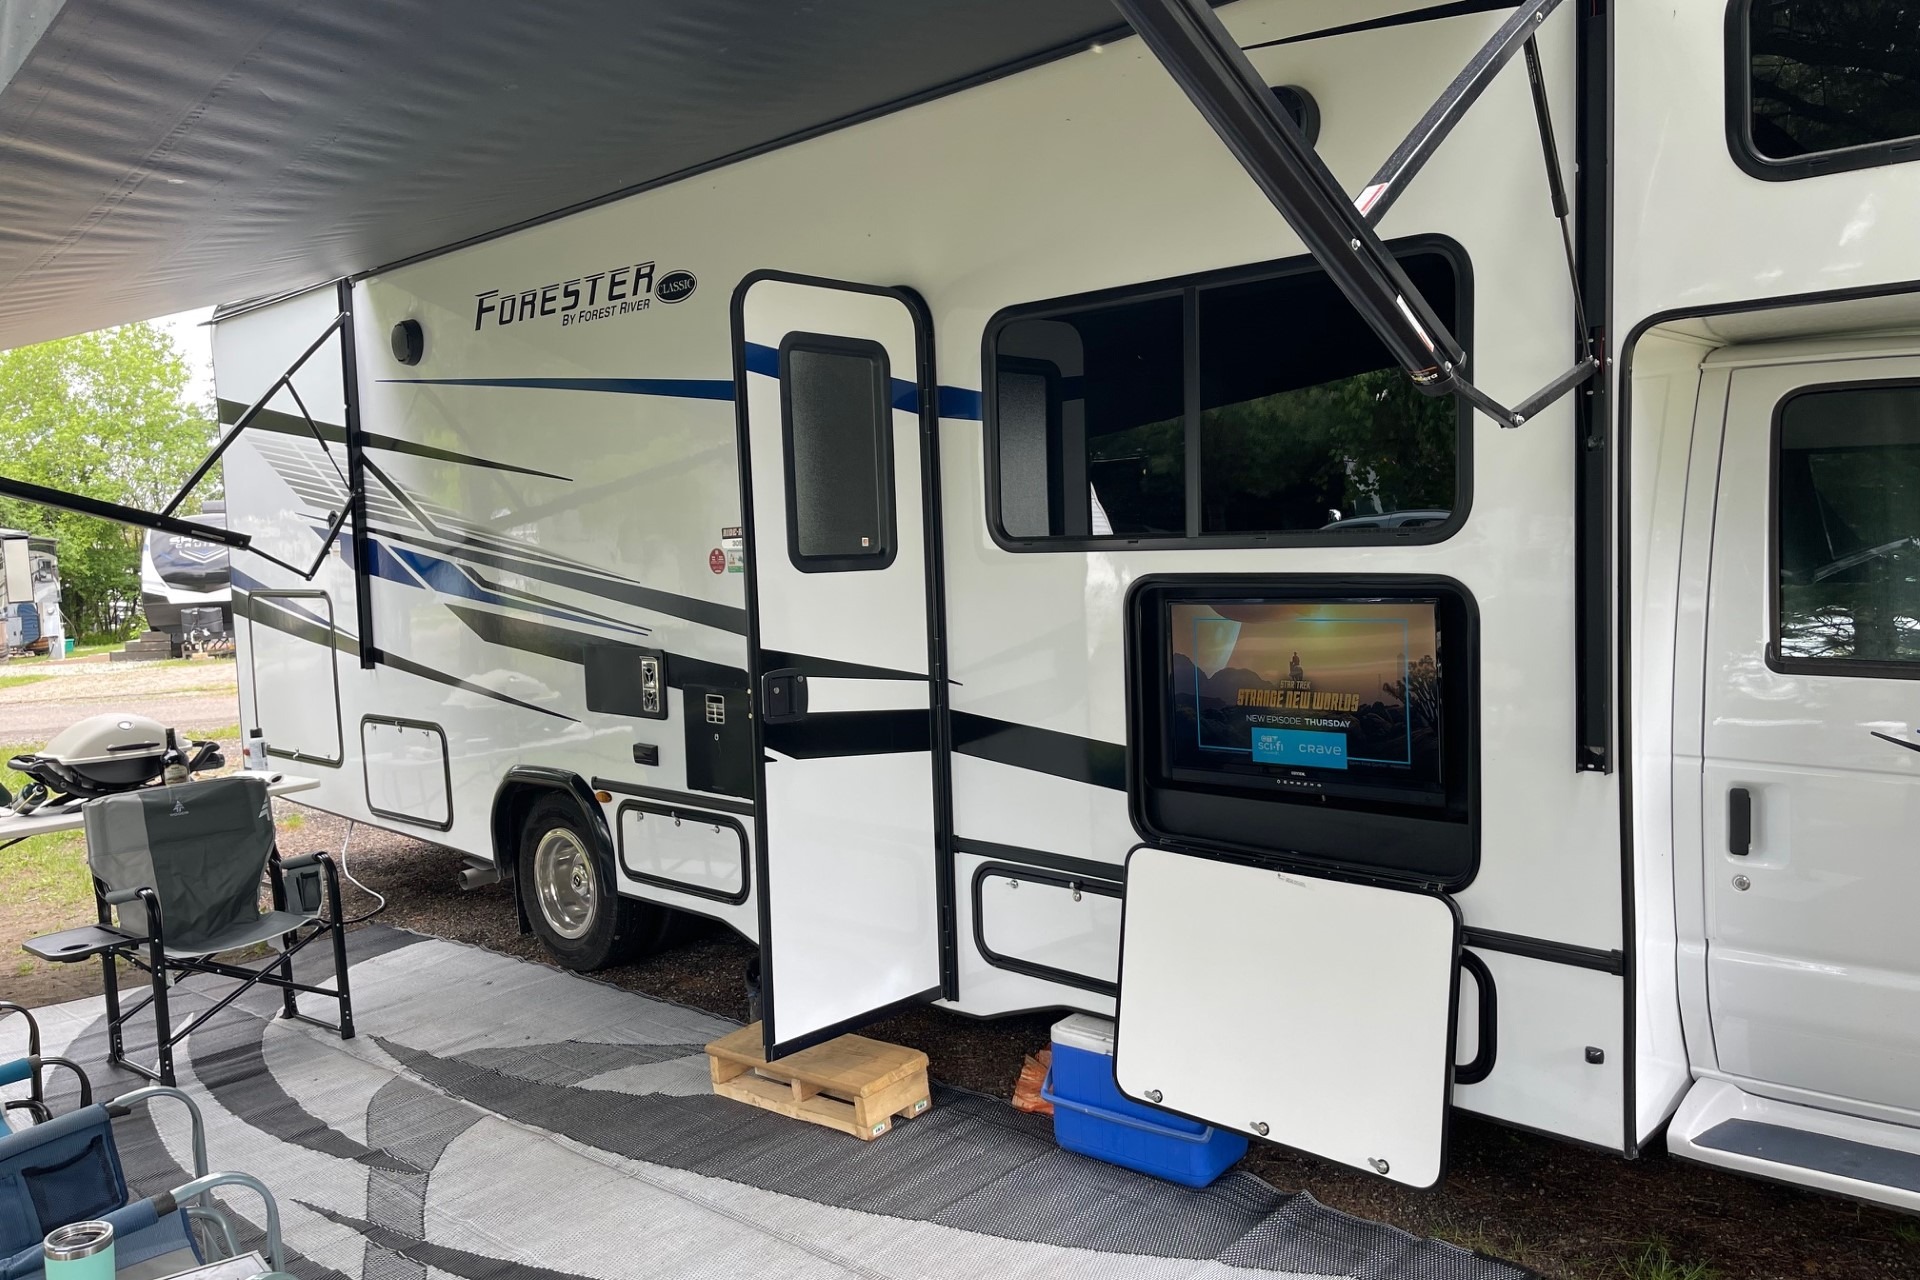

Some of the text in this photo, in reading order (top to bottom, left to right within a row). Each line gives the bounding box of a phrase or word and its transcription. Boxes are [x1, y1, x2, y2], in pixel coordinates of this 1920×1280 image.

[475, 261, 656, 331] FORESTER
[656, 278, 694, 296] CLASSIC
[562, 298, 650, 327] BY FOREST RIVER
[1280, 680, 1311, 690] STAR TREK
[1236, 688, 1360, 712] STRANGE NEW WORLDS
[1246, 714, 1351, 729] NEW EPISODE THURSDAY
